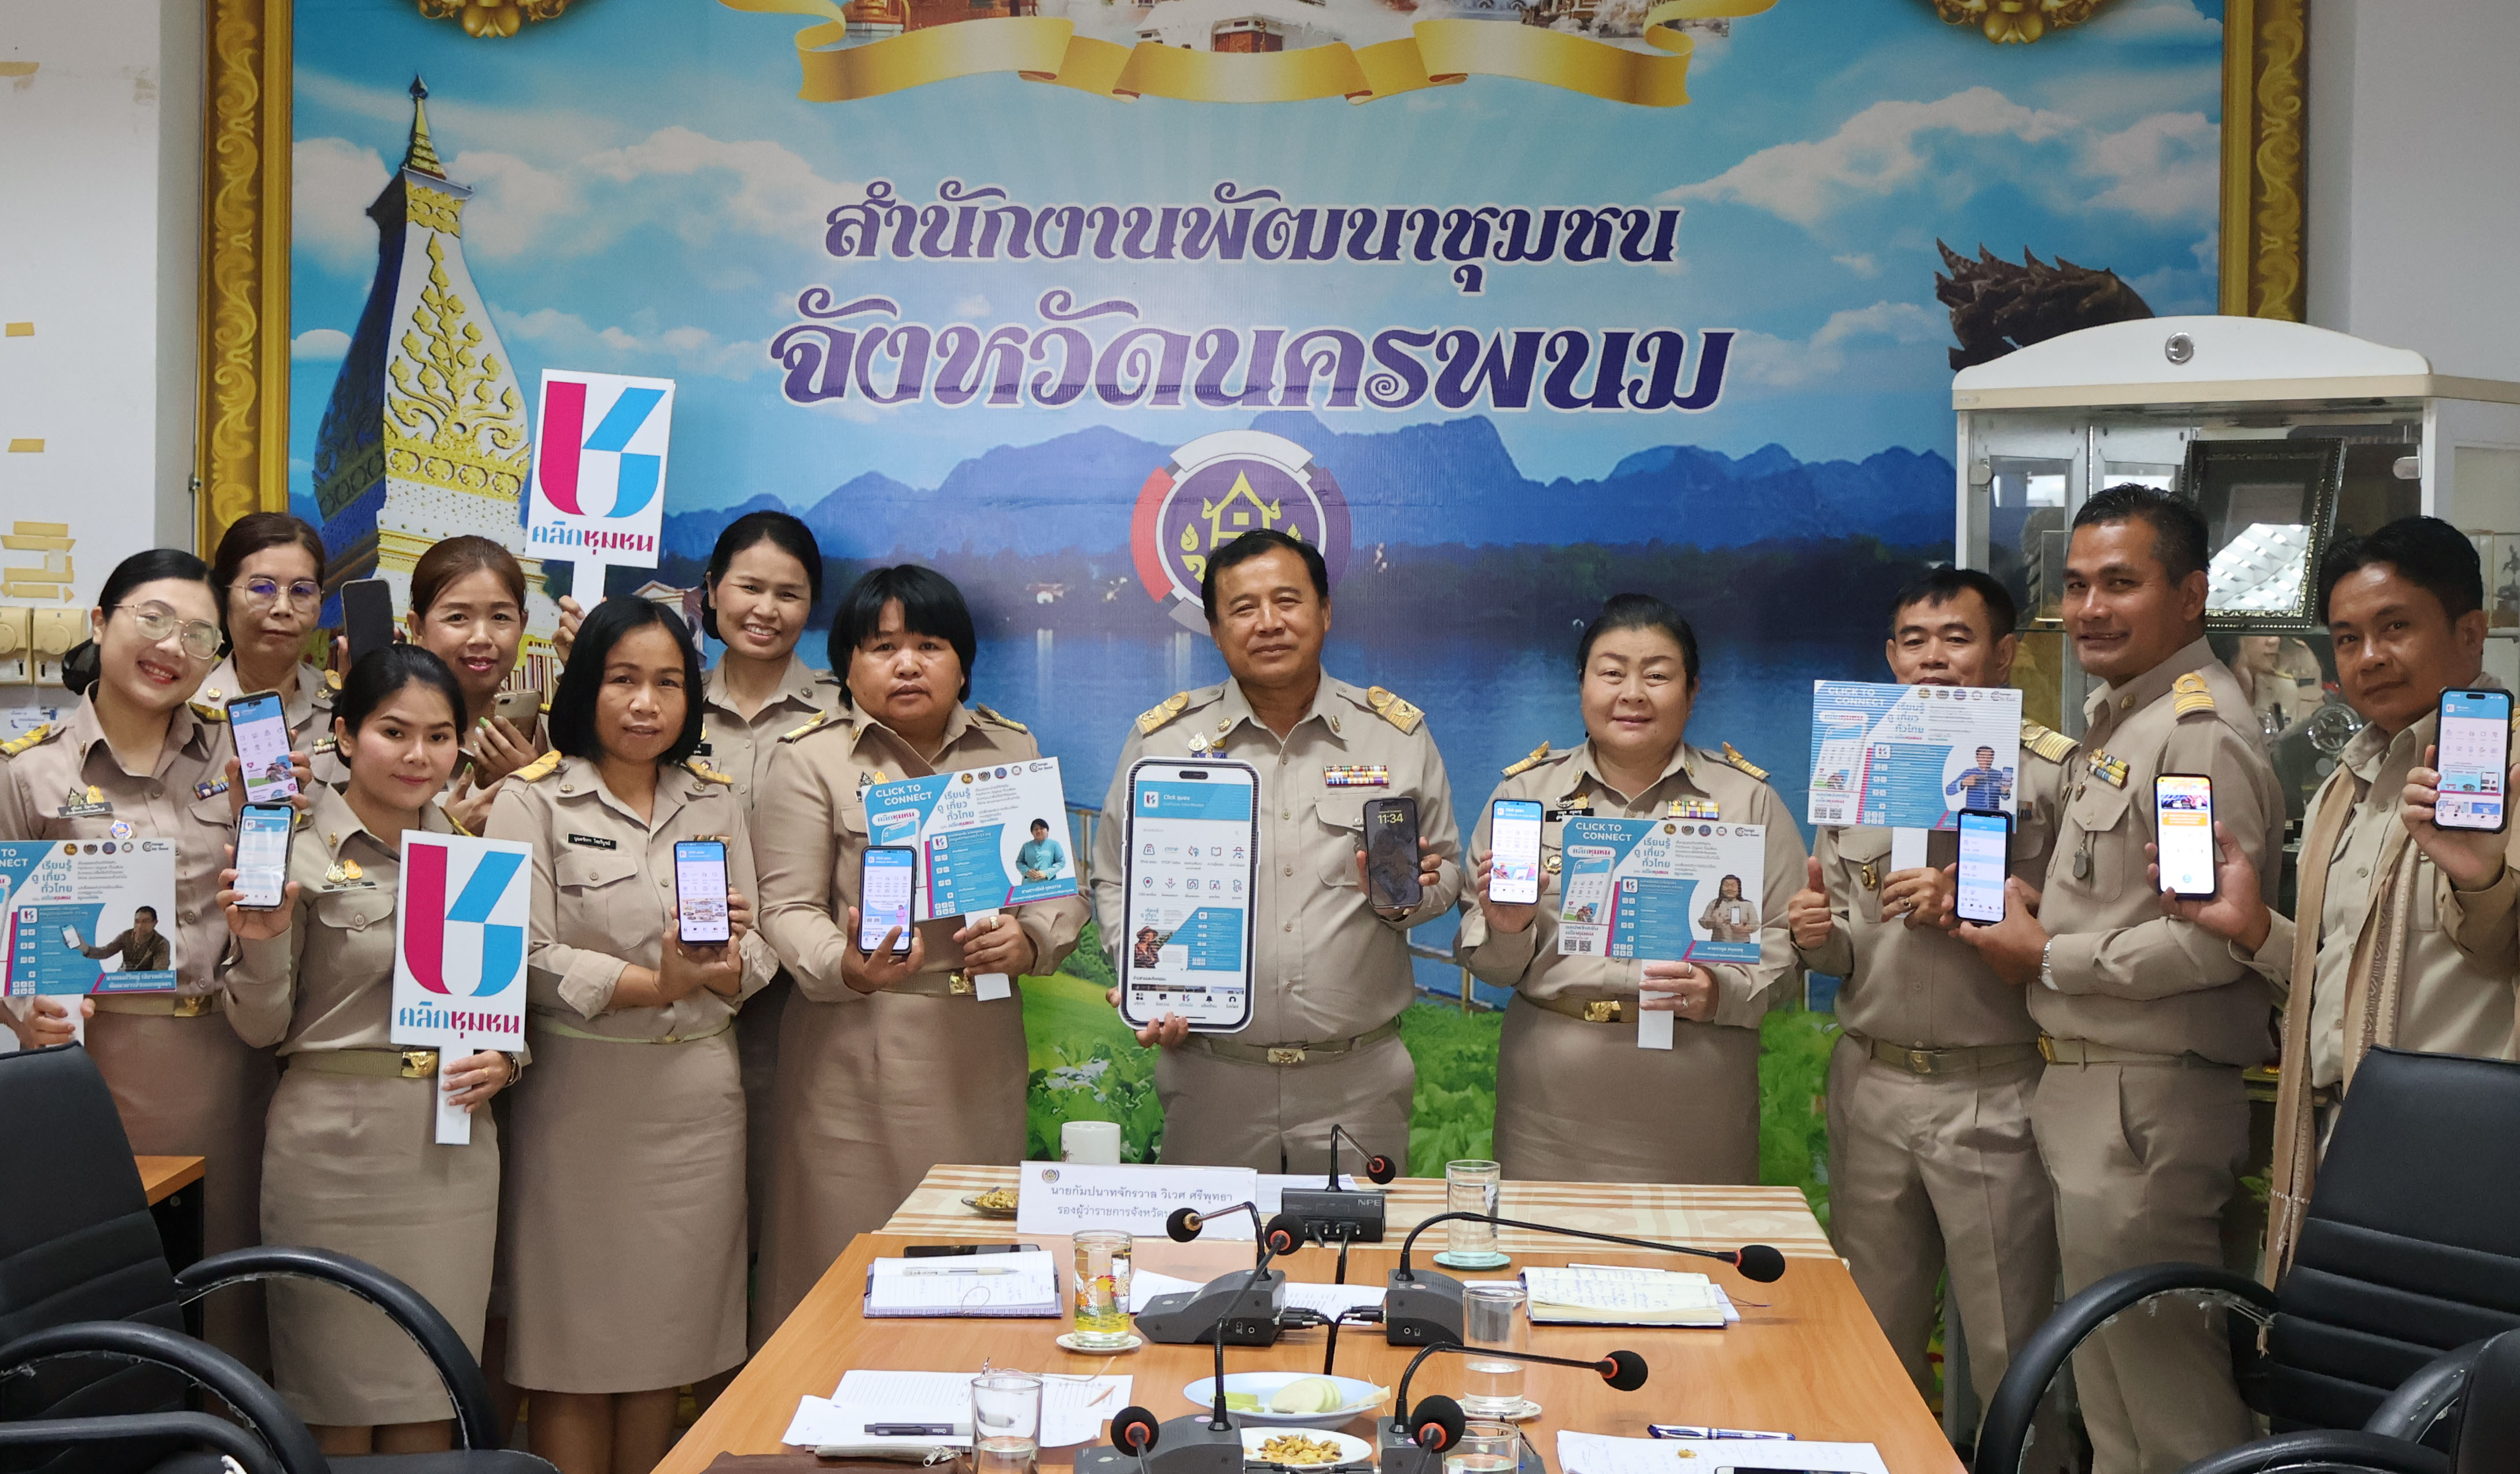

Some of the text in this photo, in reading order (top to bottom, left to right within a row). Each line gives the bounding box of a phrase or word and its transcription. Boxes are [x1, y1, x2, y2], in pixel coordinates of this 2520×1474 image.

[826, 179, 1678, 291] สำนักงานพัฒนาชุมชน
[772, 288, 1735, 407] จังหวัดนครพนม
[532, 521, 653, 555] คลิกชุมชน
[1828, 687, 1859, 695] CLICK
[875, 784, 921, 798] CLICK TO
[884, 791, 932, 806] CONNECT
[1377, 813, 1403, 824] 11:34
[1576, 822, 1622, 832] CLICK TO
[1583, 832, 1633, 842] CONNECT
[1, 849, 17, 857] TO
[399, 1001, 519, 1038] คลิกชุมชน
[1051, 1185, 1156, 1199] นายกัมปนาทจักรวาล
[1189, 1189, 1232, 1204] ศรีพุทธา
[1358, 1199, 1381, 1207] NPE
